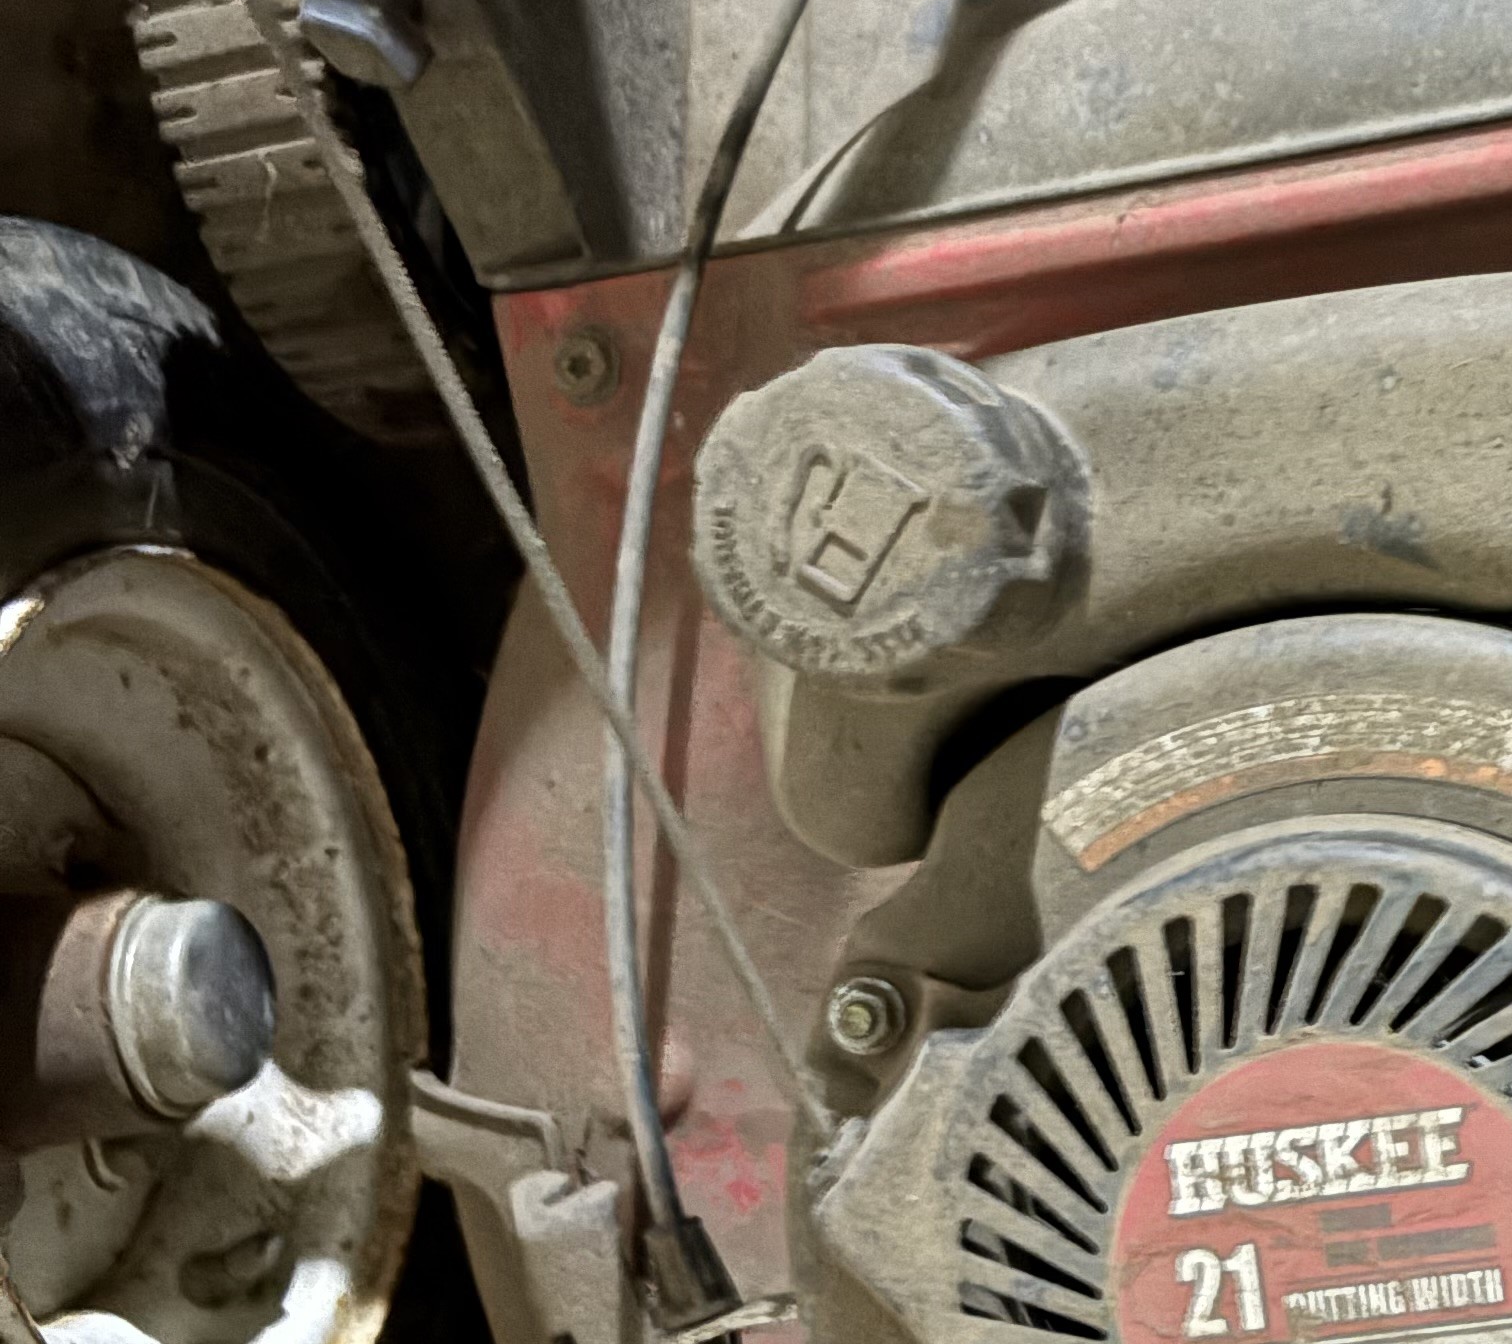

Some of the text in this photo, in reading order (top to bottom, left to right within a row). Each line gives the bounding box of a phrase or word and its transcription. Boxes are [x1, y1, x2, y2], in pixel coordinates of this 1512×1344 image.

[1164, 1107, 1471, 1216] HUSKEE
[1175, 1243, 1266, 1338] 21
[1410, 1268, 1505, 1312] WIDTH
